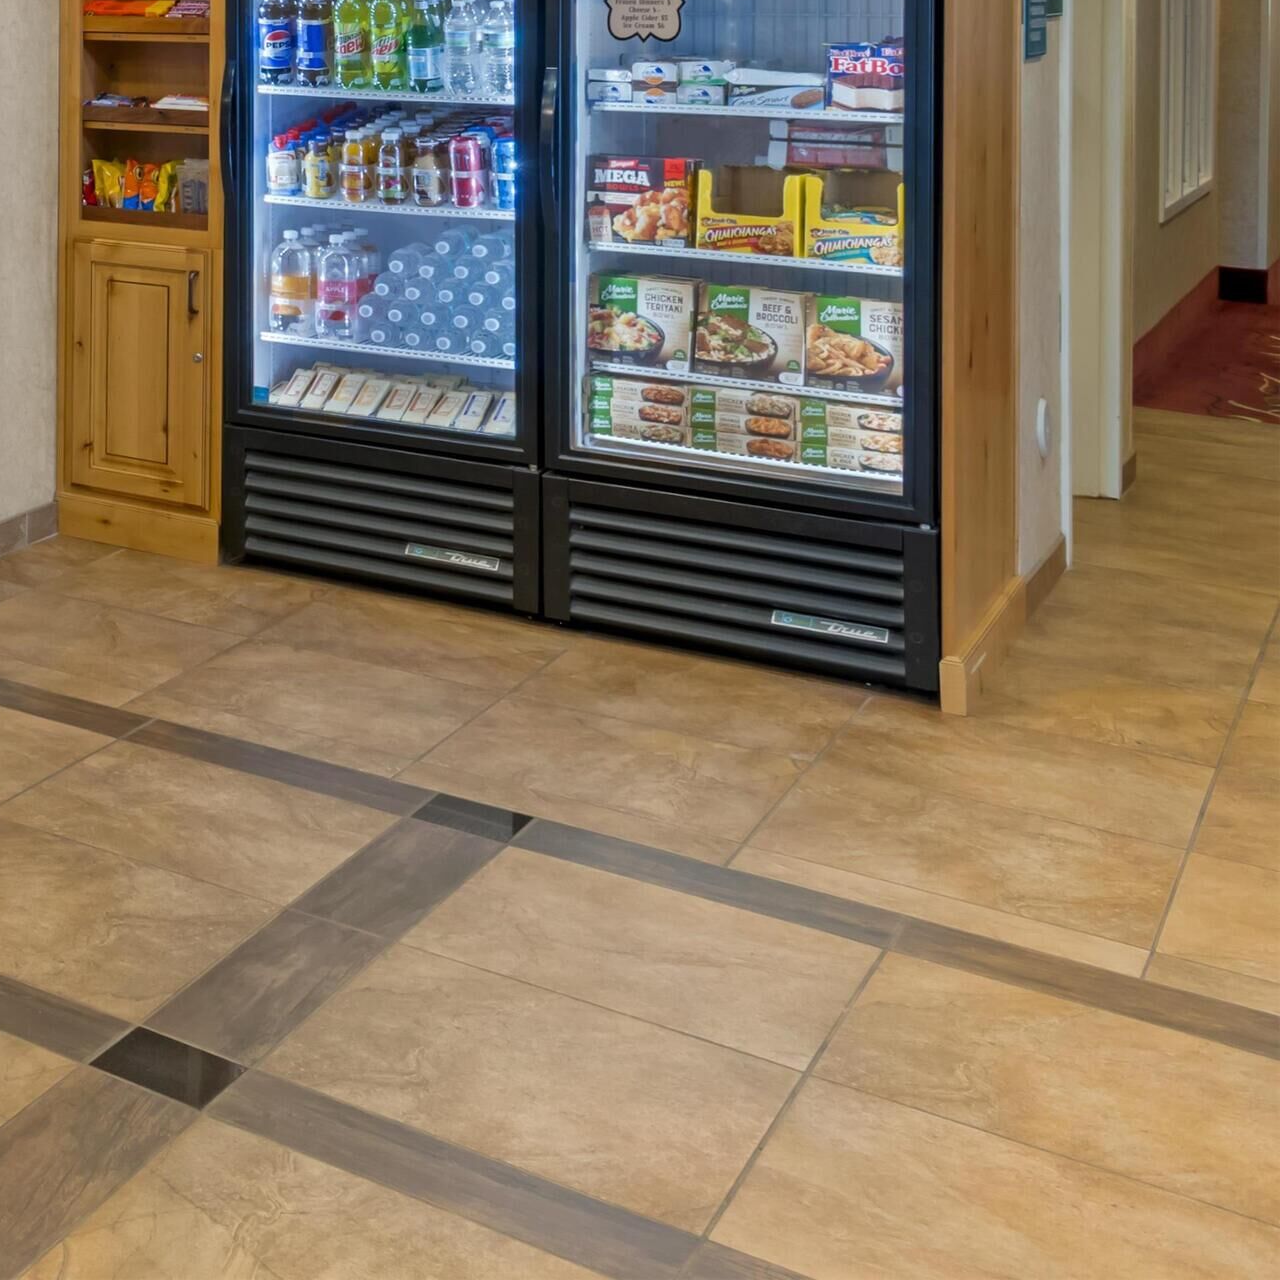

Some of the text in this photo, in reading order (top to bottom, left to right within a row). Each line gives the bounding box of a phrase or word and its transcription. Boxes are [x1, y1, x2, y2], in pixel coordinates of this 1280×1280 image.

[593, 168, 651, 186] MEGA
[705, 225, 777, 242] CHIMICHANGAS
[814, 236, 893, 255] CHIMICHANGAS
[644, 293, 683, 304] CHICKEN
[645, 302, 683, 313] TERIYAKI
[762, 303, 782, 312] BEEF
[756, 312, 798, 324] BROCCOLI
